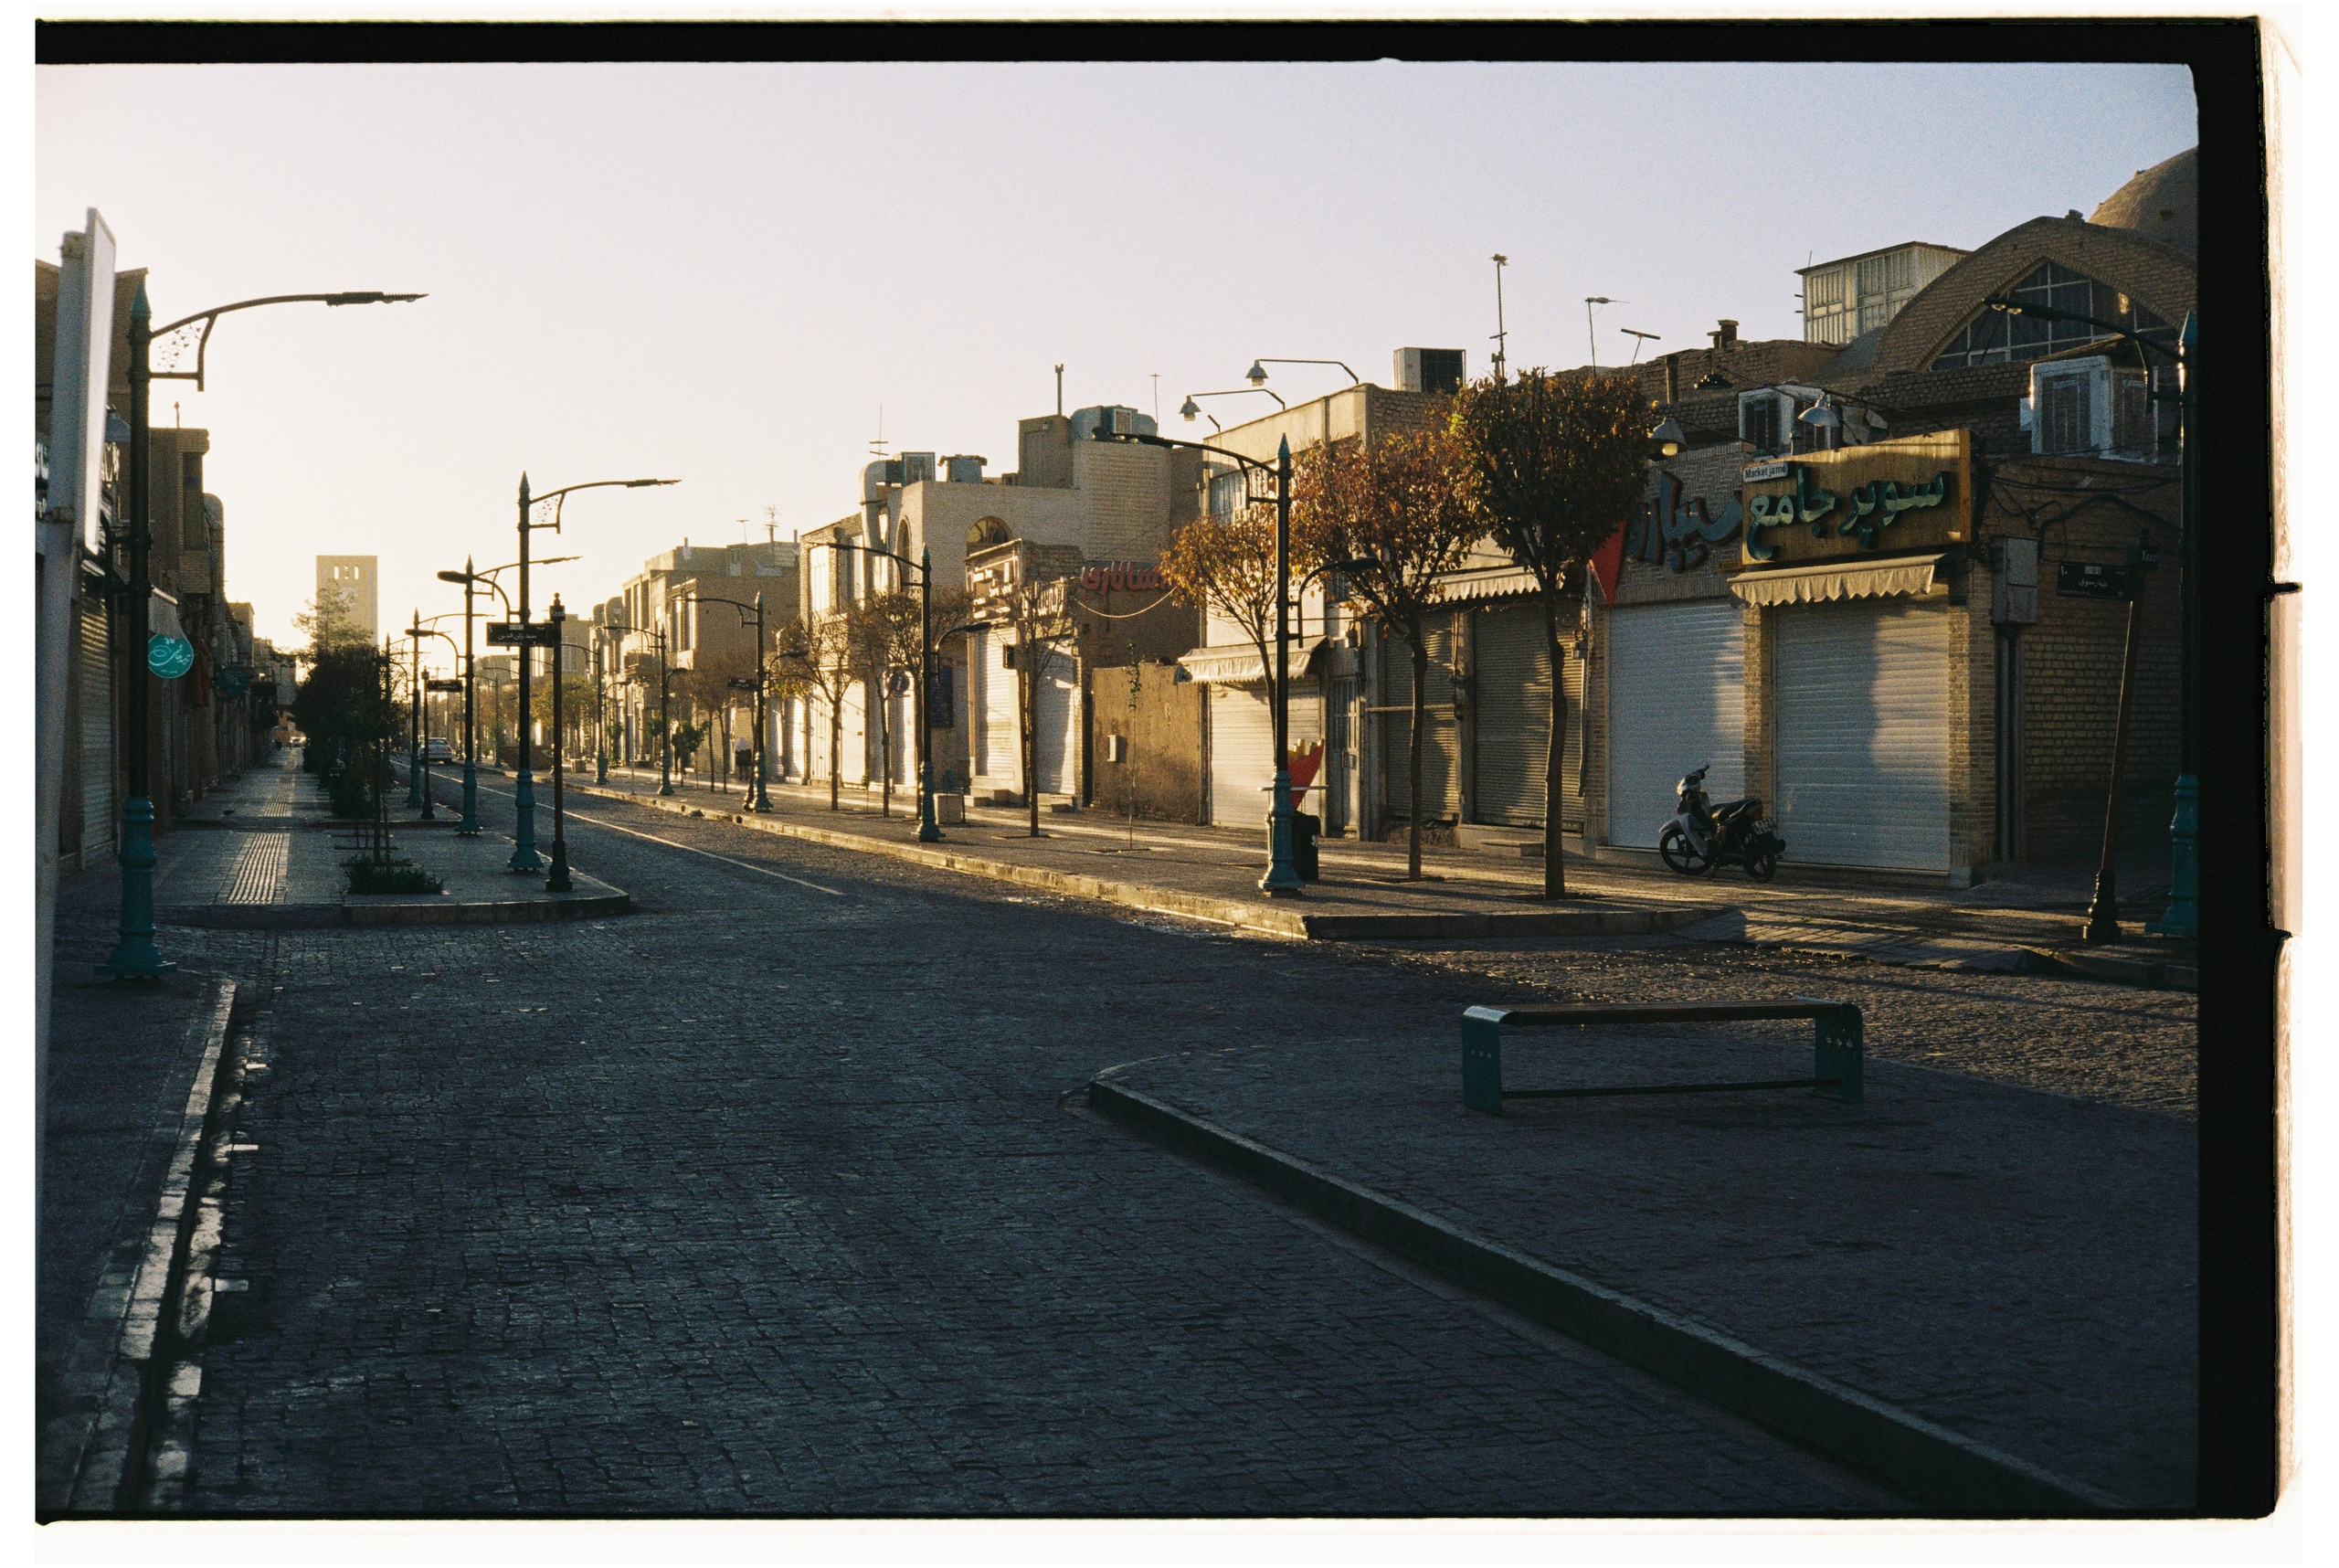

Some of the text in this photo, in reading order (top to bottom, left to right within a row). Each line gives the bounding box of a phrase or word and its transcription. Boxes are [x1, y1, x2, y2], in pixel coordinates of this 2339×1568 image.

[1744, 467, 1768, 480] Market
[1747, 467, 1950, 562] سوپر جامع
